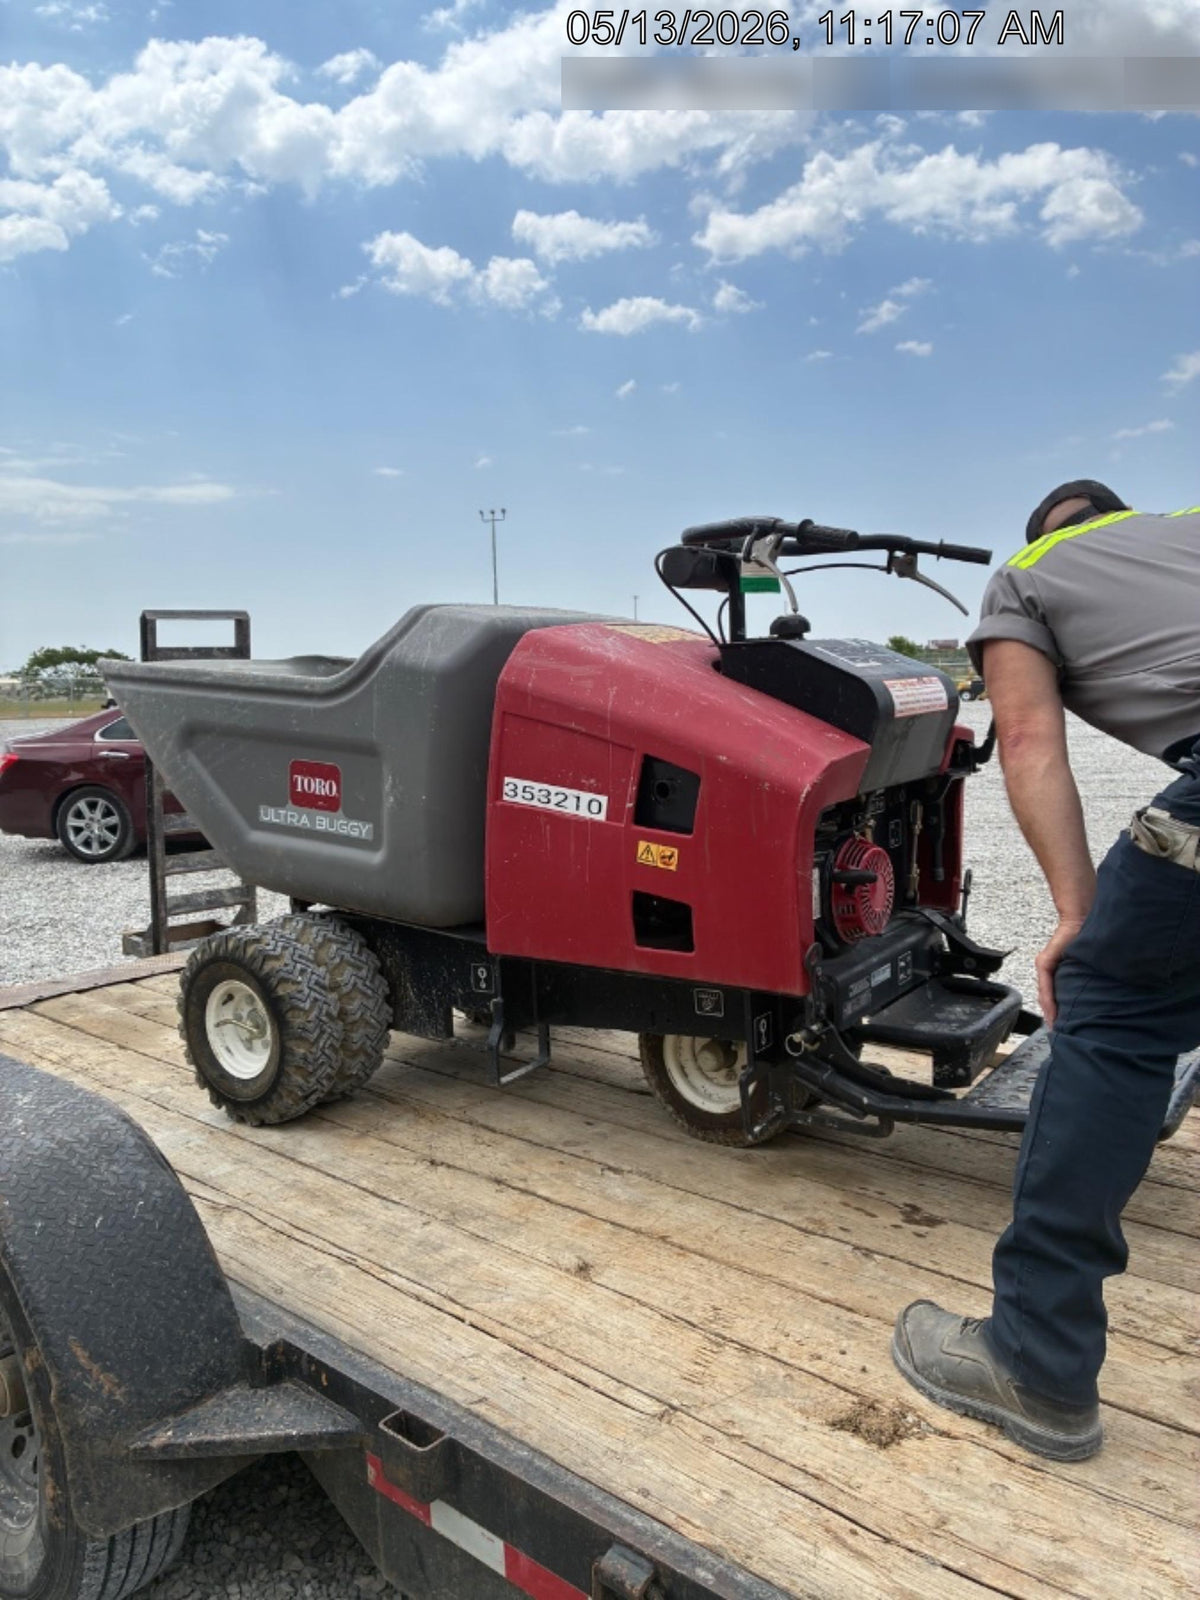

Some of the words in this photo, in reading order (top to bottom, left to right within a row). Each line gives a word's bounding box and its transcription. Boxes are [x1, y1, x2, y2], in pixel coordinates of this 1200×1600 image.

[293, 775, 338, 797] TORO
[504, 781, 602, 815] 353210
[260, 806, 310, 828] ULTRA
[316, 816, 370, 838] BUGGY
